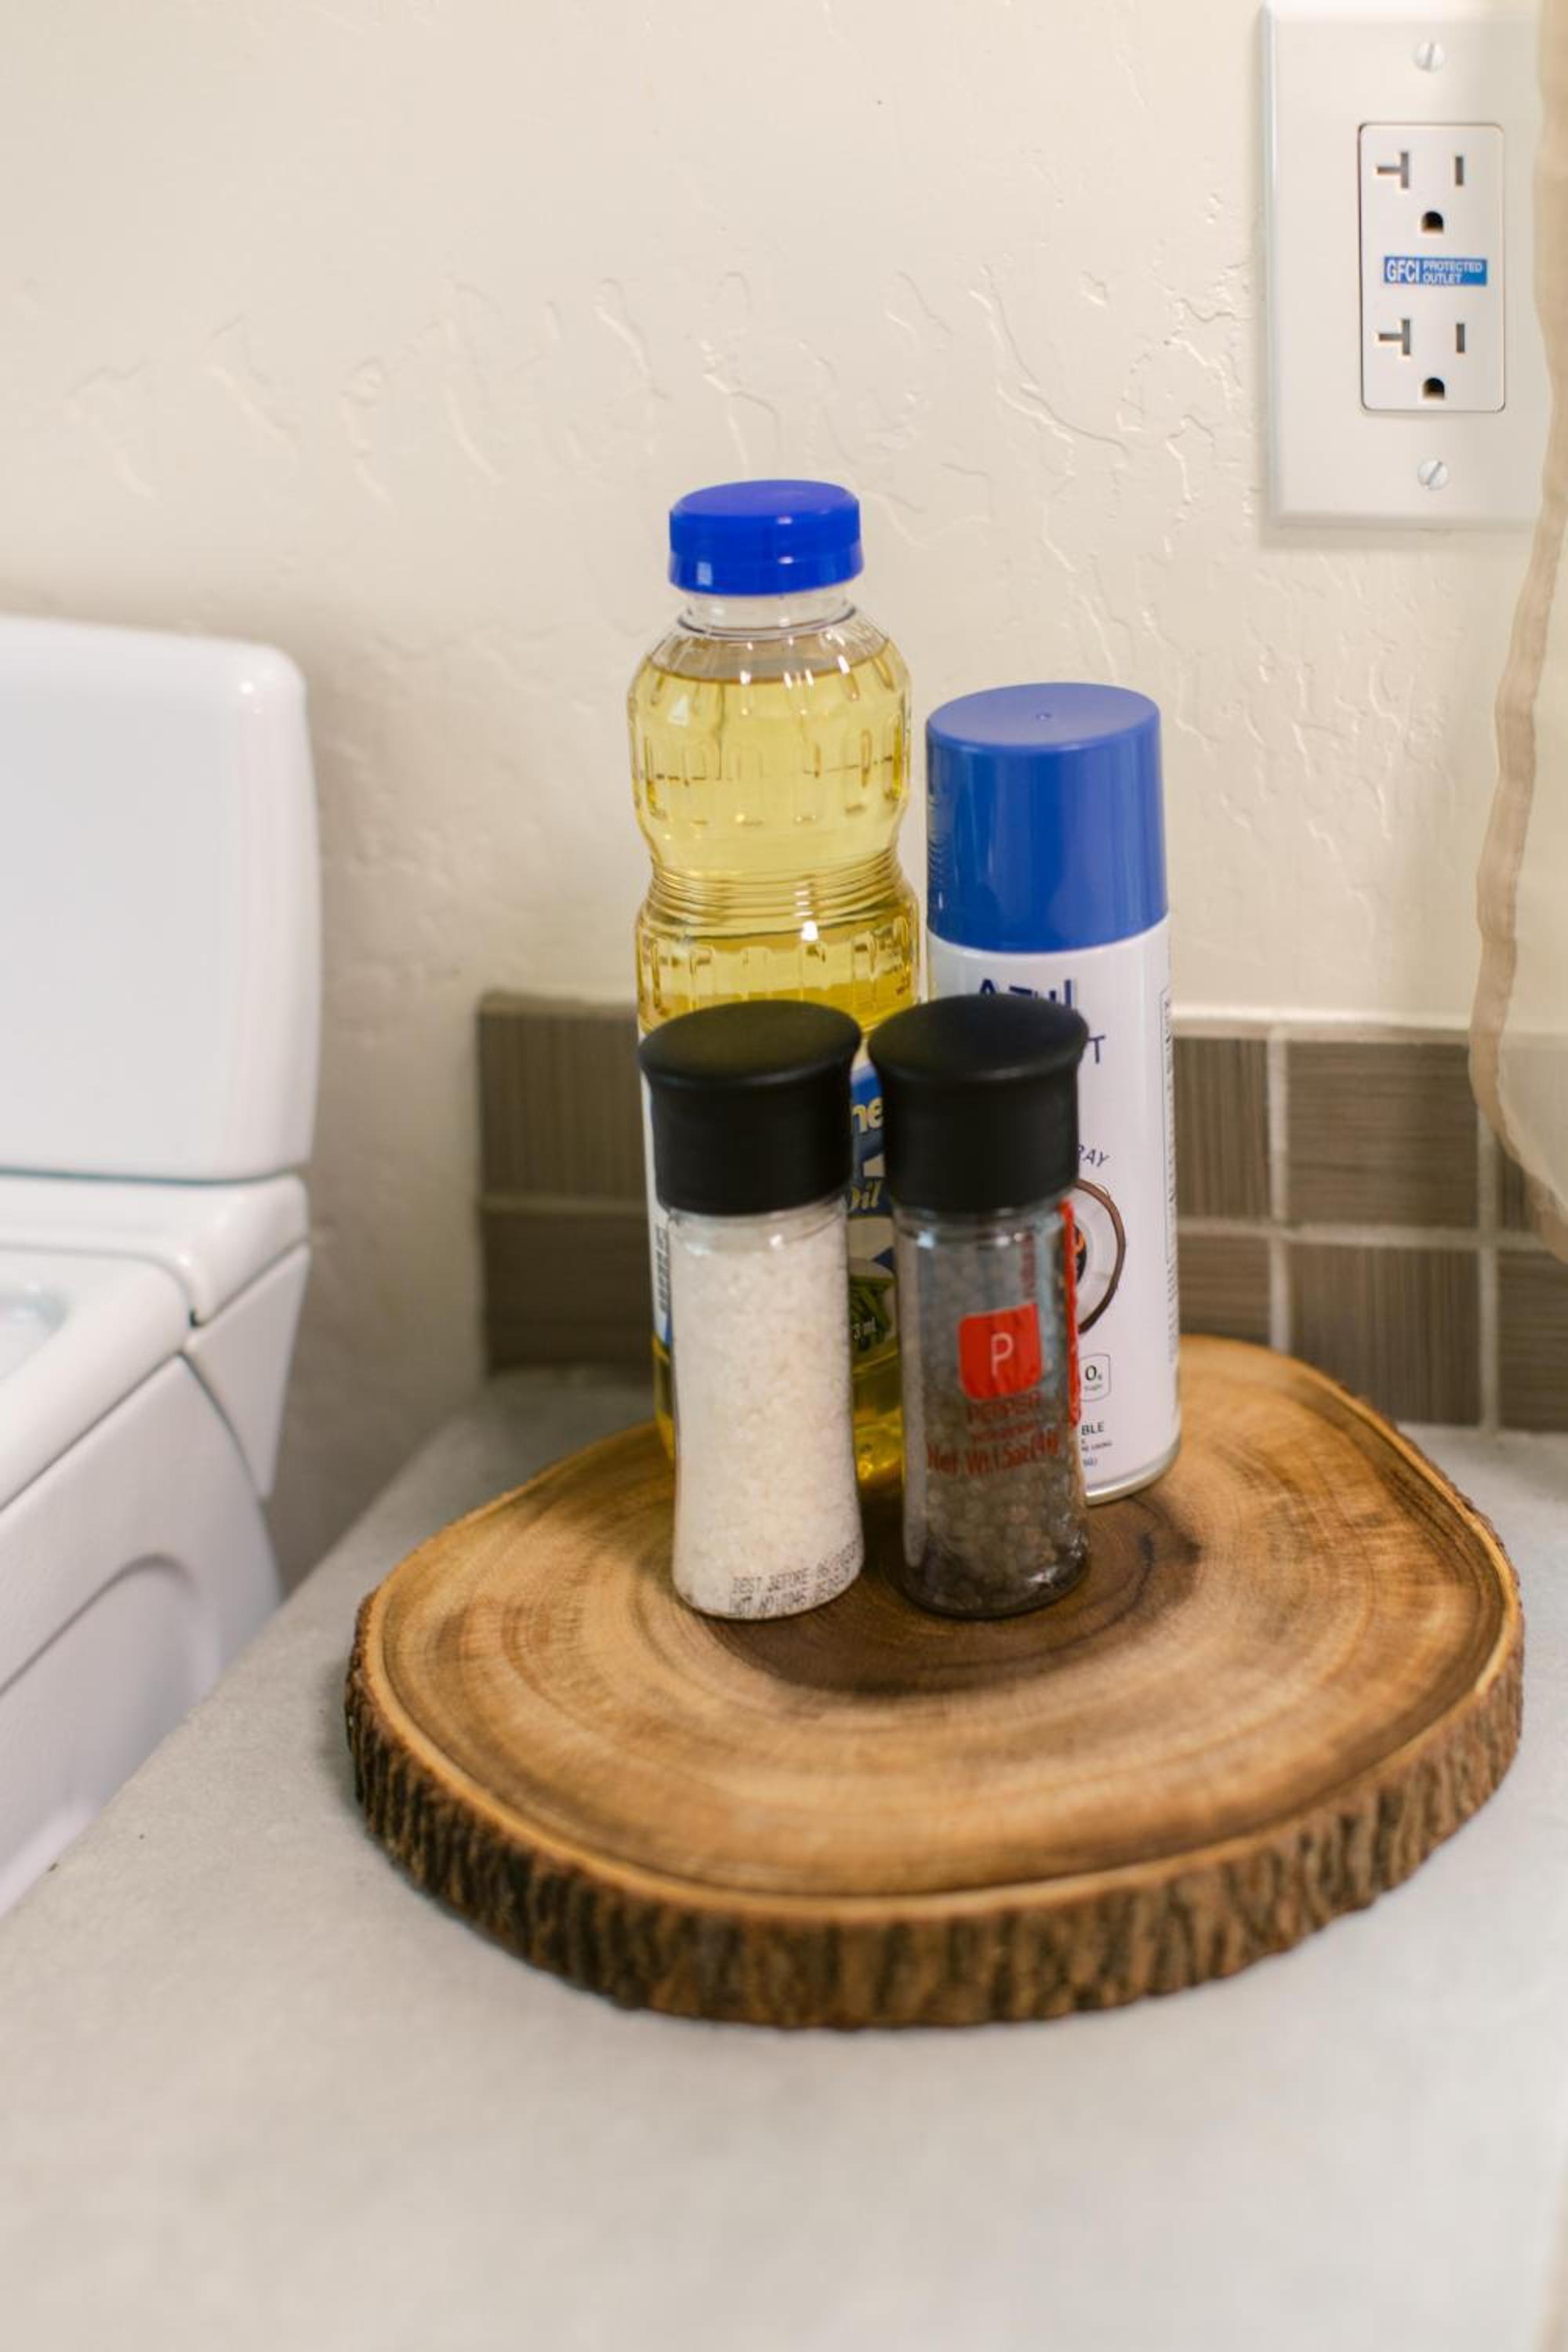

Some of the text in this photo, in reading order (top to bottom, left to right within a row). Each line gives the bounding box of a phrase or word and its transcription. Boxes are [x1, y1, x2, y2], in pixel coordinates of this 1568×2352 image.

[1386, 260, 1420, 281] GFCI
[1423, 260, 1483, 273] PROTECTED
[1423, 273, 1462, 284] OUTLET
[989, 1331, 1014, 1378] P
